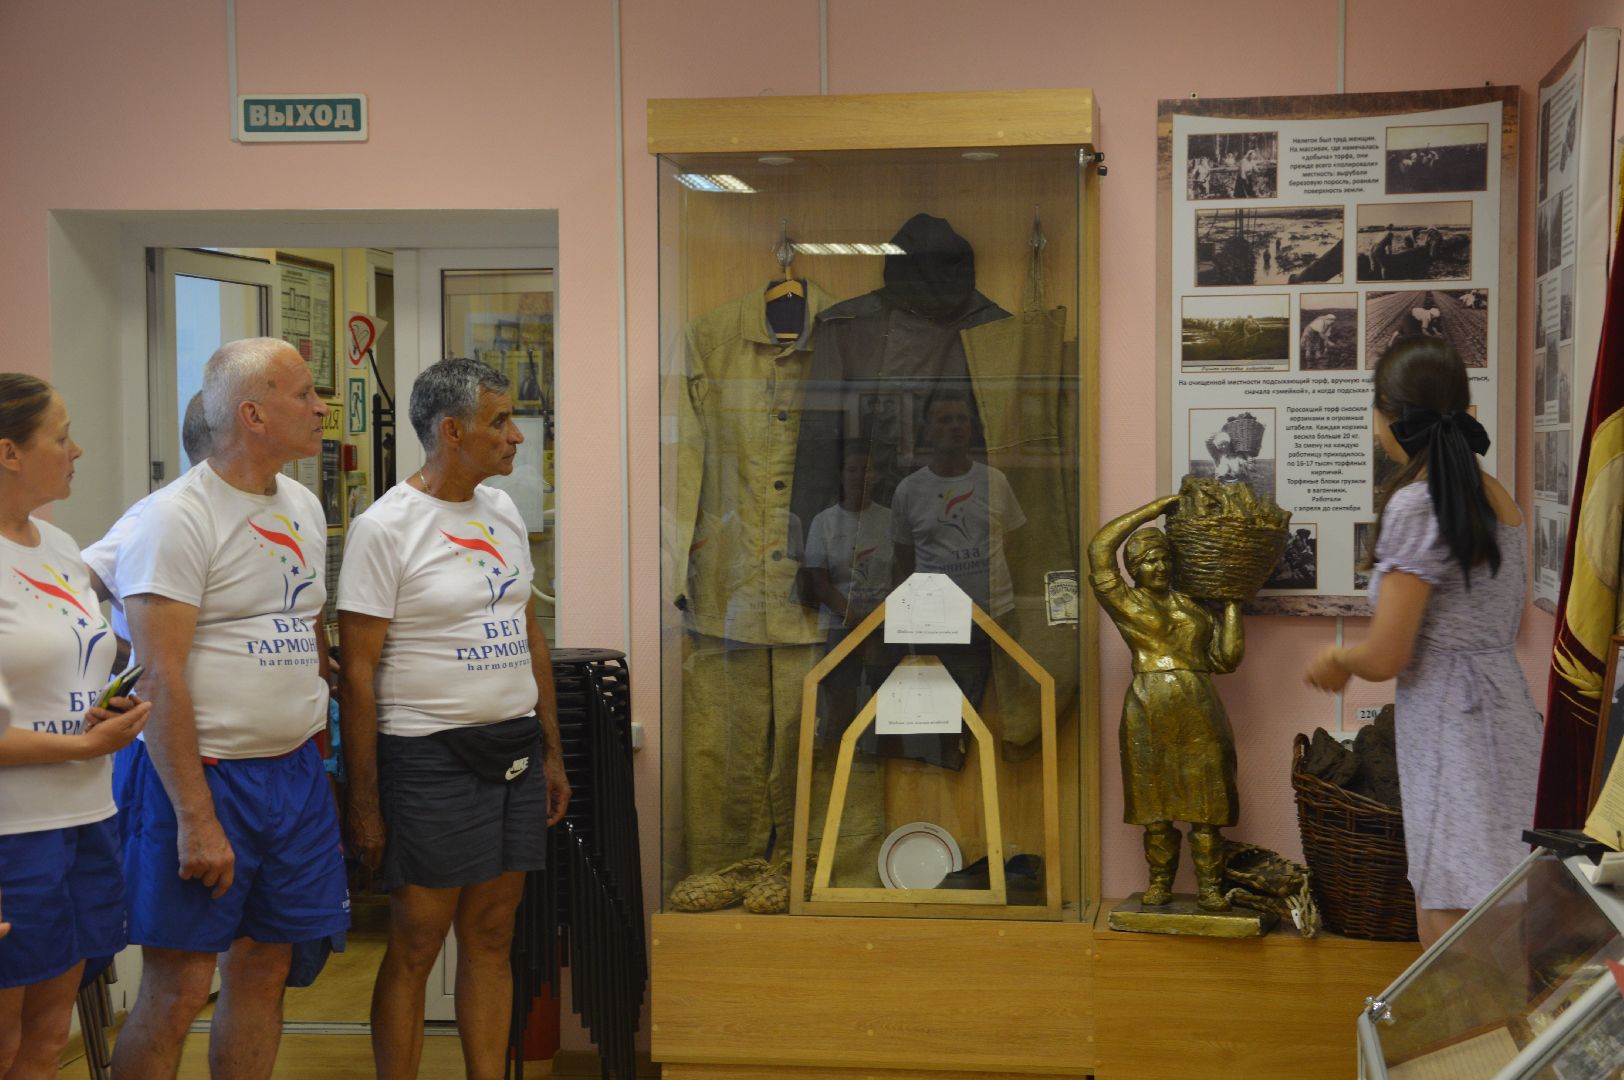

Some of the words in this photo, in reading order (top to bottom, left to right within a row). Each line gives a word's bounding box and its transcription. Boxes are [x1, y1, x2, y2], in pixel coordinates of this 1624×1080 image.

[249, 104, 354, 128] ВЫХОД
[1335, 153, 1355, 161] торфа,
[1288, 451, 1322, 459] работницу
[1331, 504, 1361, 512] сентября
[272, 617, 309, 633] БЕГ
[483, 618, 520, 639] БЕГ
[246, 637, 318, 654] ГАРМОН
[69, 690, 103, 712] БЕ
